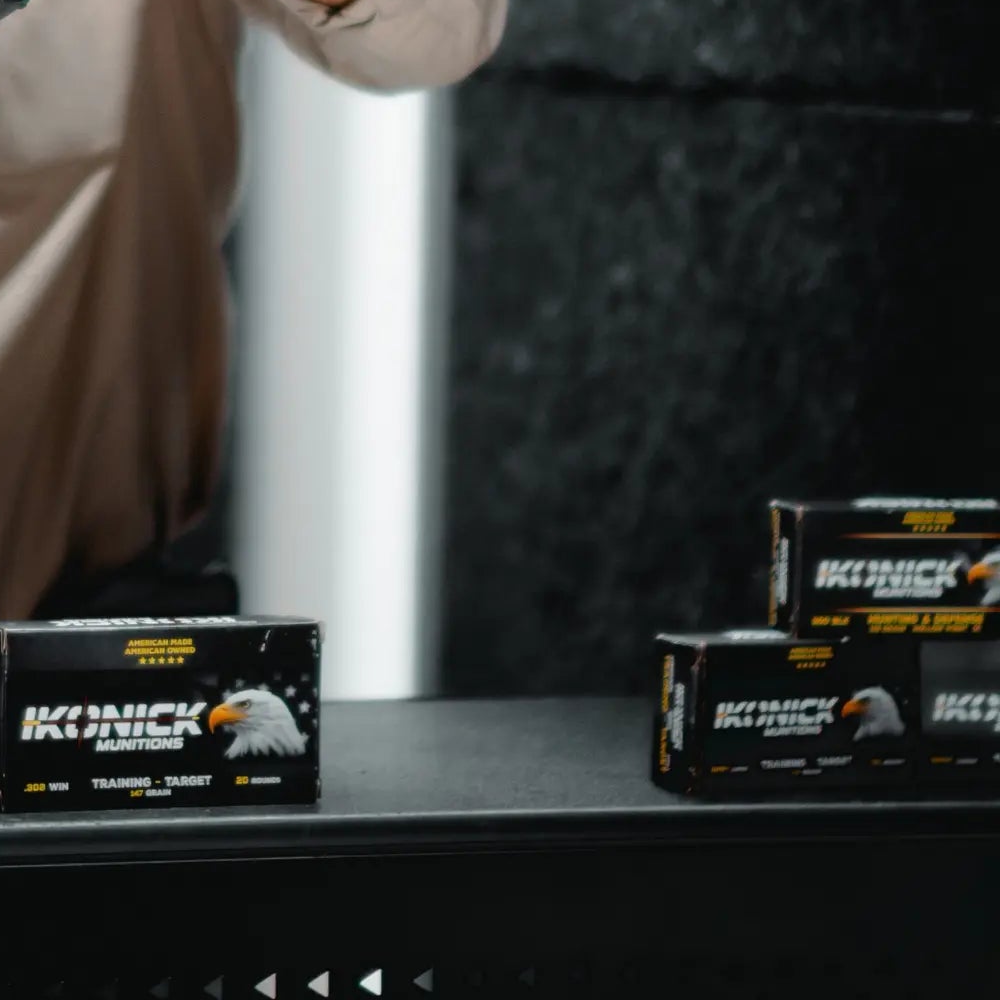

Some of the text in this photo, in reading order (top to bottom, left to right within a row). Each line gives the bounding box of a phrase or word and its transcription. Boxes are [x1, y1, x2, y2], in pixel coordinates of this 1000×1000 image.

[815, 559, 962, 588] IKONICK
[170, 638, 193, 646] MADE
[124, 646, 196, 655] AMERICAN OWNED
[714, 696, 839, 729] IKONICK
[21, 702, 207, 740] IKONICK
[96, 737, 184, 752] MUNITIONS
[92, 777, 151, 789] TRAINING
[164, 775, 212, 786] TARGET
[235, 776, 249, 785] 20
[49, 783, 69, 791] WIN
[145, 788, 171, 796] GRAIN
